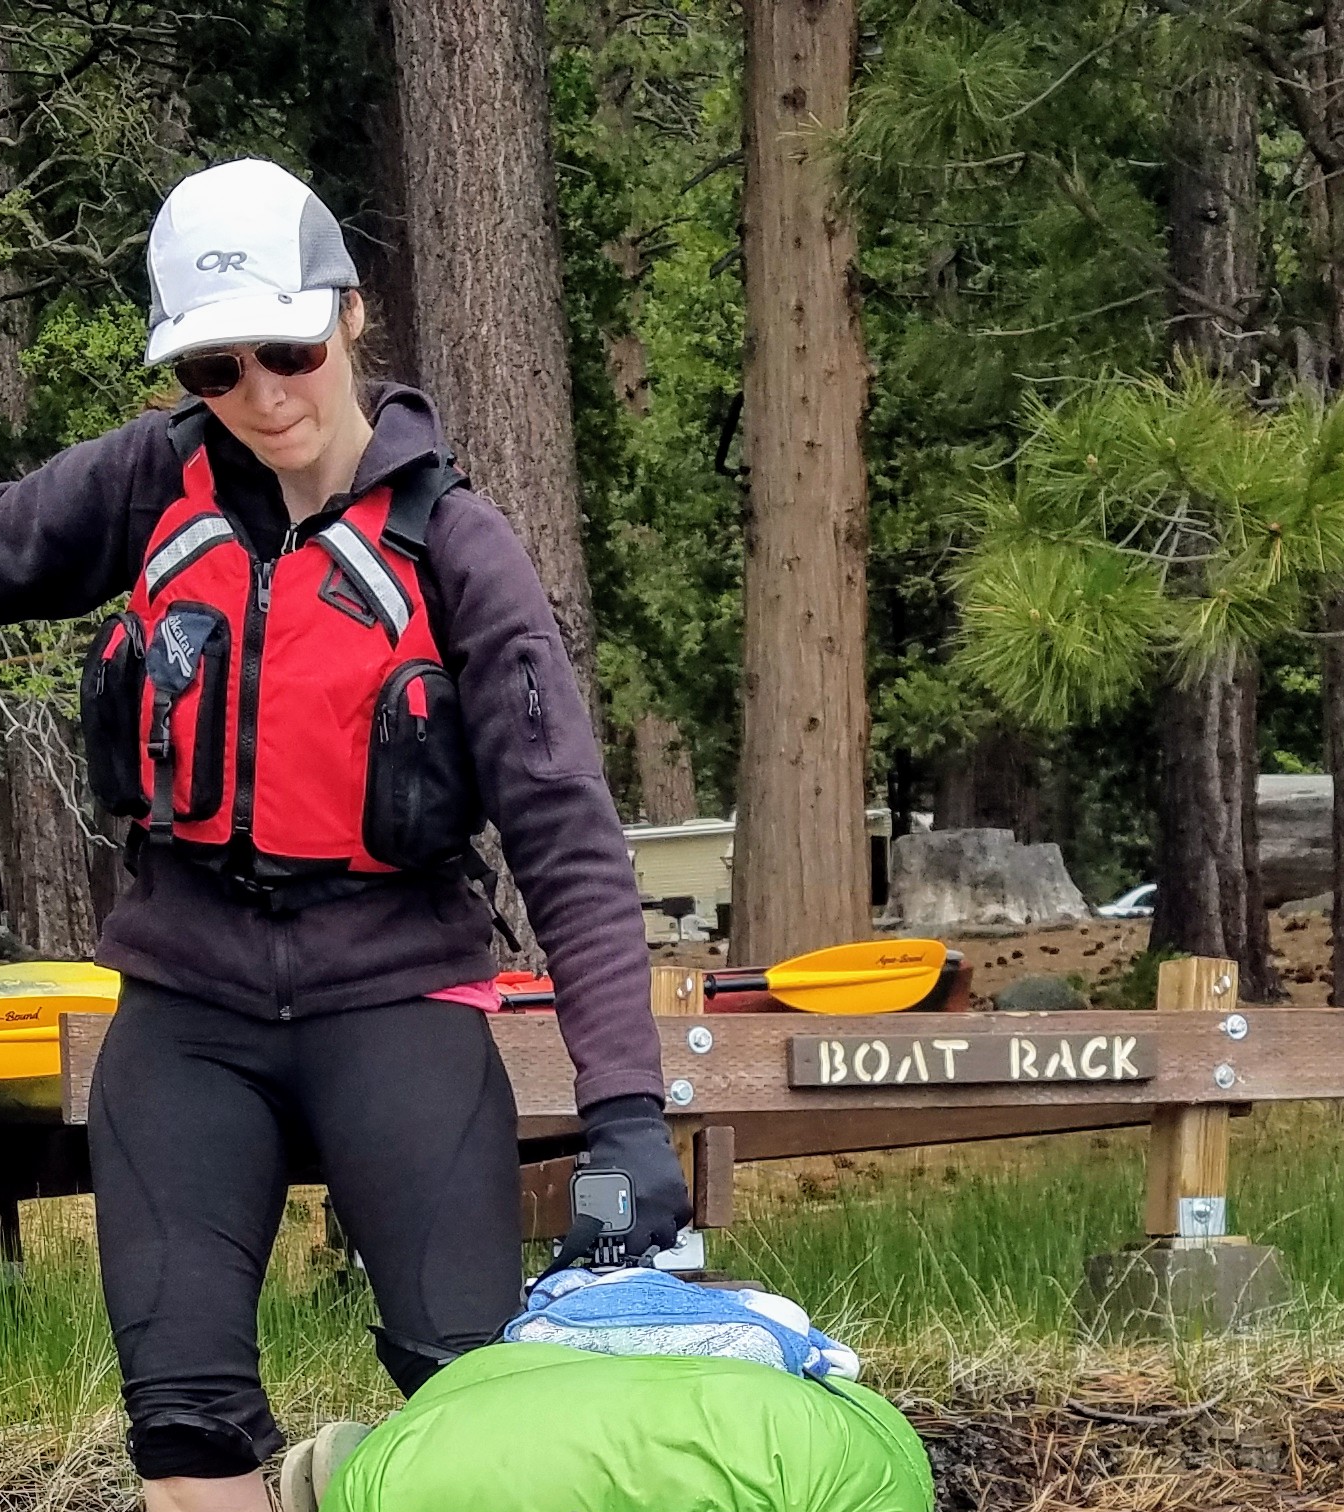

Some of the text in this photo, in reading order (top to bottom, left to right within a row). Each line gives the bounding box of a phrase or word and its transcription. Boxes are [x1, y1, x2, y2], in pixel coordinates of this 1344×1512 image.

[196, 250, 248, 273] OR
[818, 1036, 1139, 1083] BOAT RACK
